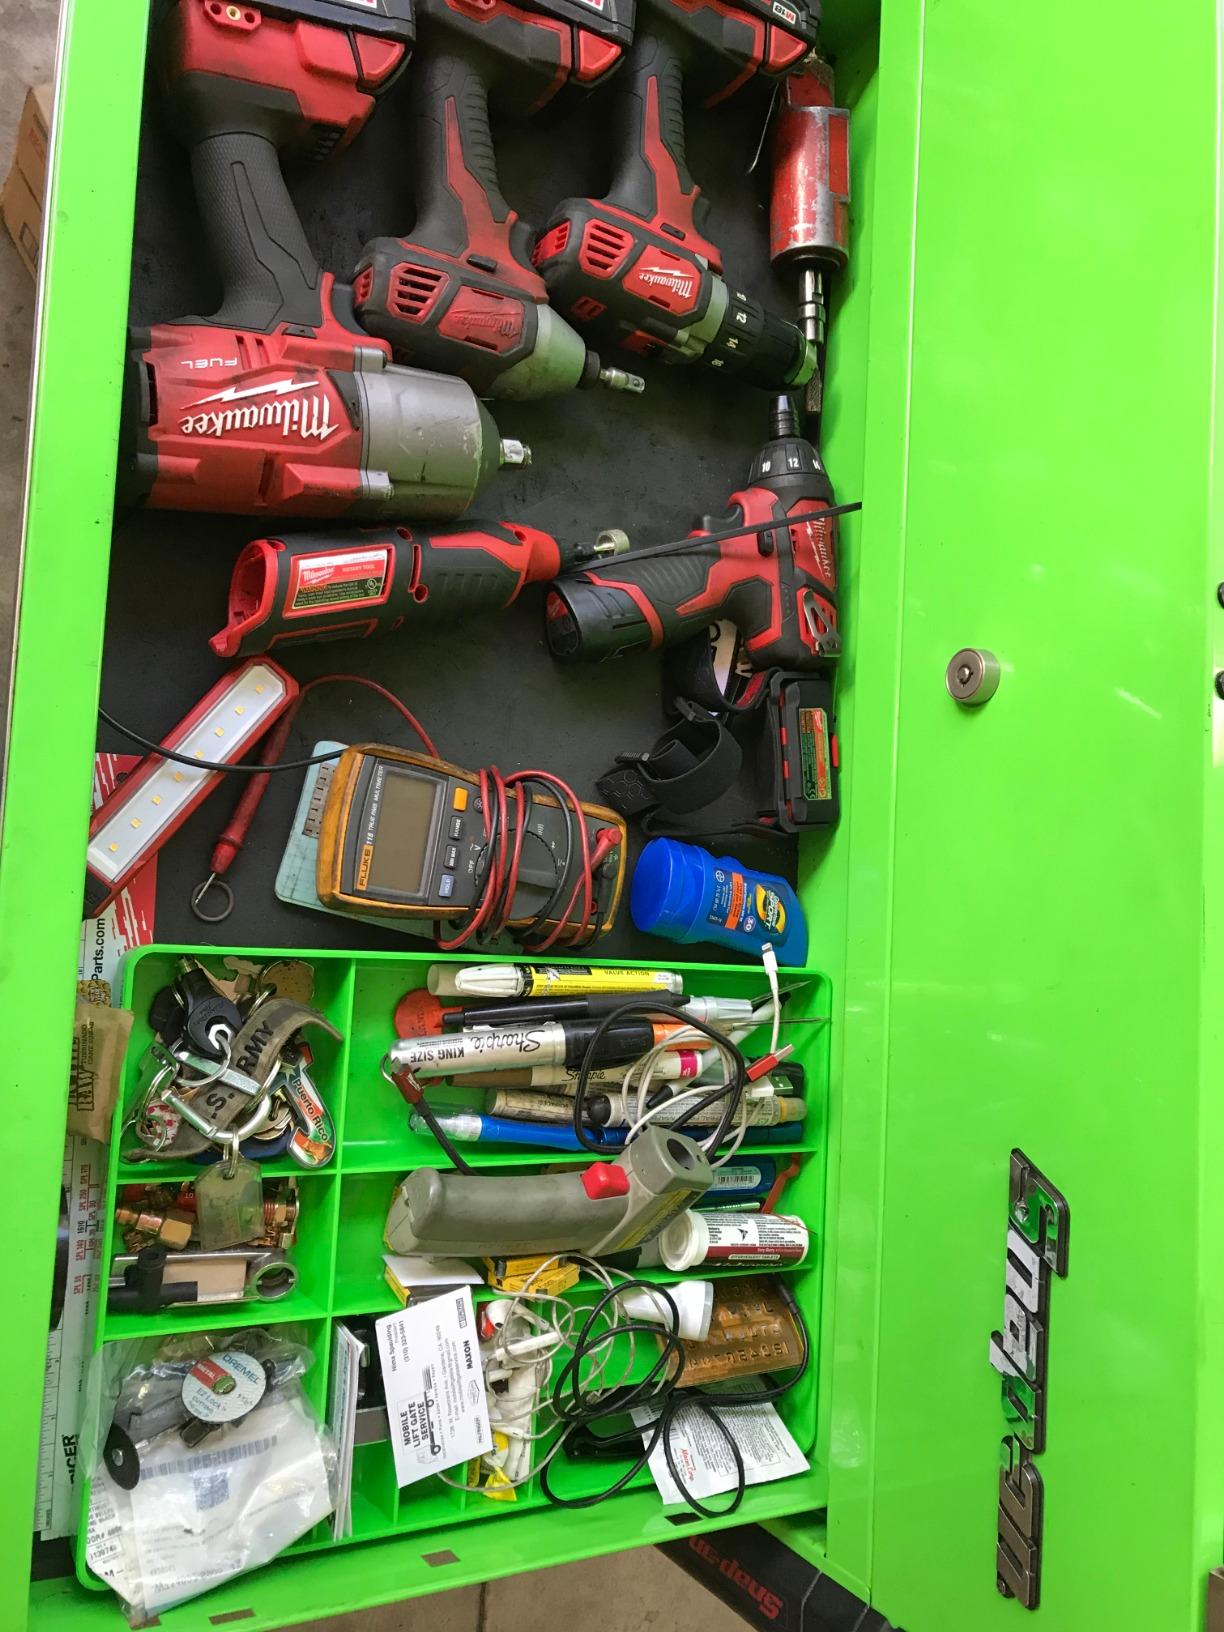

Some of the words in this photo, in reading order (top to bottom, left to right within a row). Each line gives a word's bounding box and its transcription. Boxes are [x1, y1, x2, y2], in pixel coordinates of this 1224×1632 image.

[774, 5, 795, 20] M18
[638, 272, 692, 299] Milwaukee
[735, 312, 748, 324] 12
[726, 337, 740, 349] 14
[181, 357, 237, 369] FUEL
[178, 393, 339, 441] Milwaukee
[762, 461, 771, 472] 10
[788, 458, 799, 468] 12
[358, 849, 371, 887] FLUKE
[366, 833, 374, 845] 115
[373, 765, 384, 801] MULTIMETER
[454, 819, 462, 837] RANGE
[467, 860, 475, 873] OFF
[765, 891, 776, 930] SPORT
[626, 969, 650, 977] ACTION
[470, 1028, 546, 1054] Sharpie
[410, 1050, 437, 1064] SIZE
[439, 1046, 465, 1061] KING
[77, 1066, 94, 1112] RAW
[292, 1078, 314, 1115] Puerto
[311, 1115, 329, 1142] Rico
[463, 1340, 474, 1370] MAXON
[197, 1363, 217, 1380] METAL
[222, 1353, 261, 1385] DREMEL
[990, 1149, 1071, 1609] Snap-on
[196, 1388, 206, 1397] EZ
[408, 1401, 418, 1426] GATE
[417, 1401, 429, 1441] SERVICE
[400, 1410, 411, 1446] MOBILE
[411, 1429, 421, 1448] LIFT
